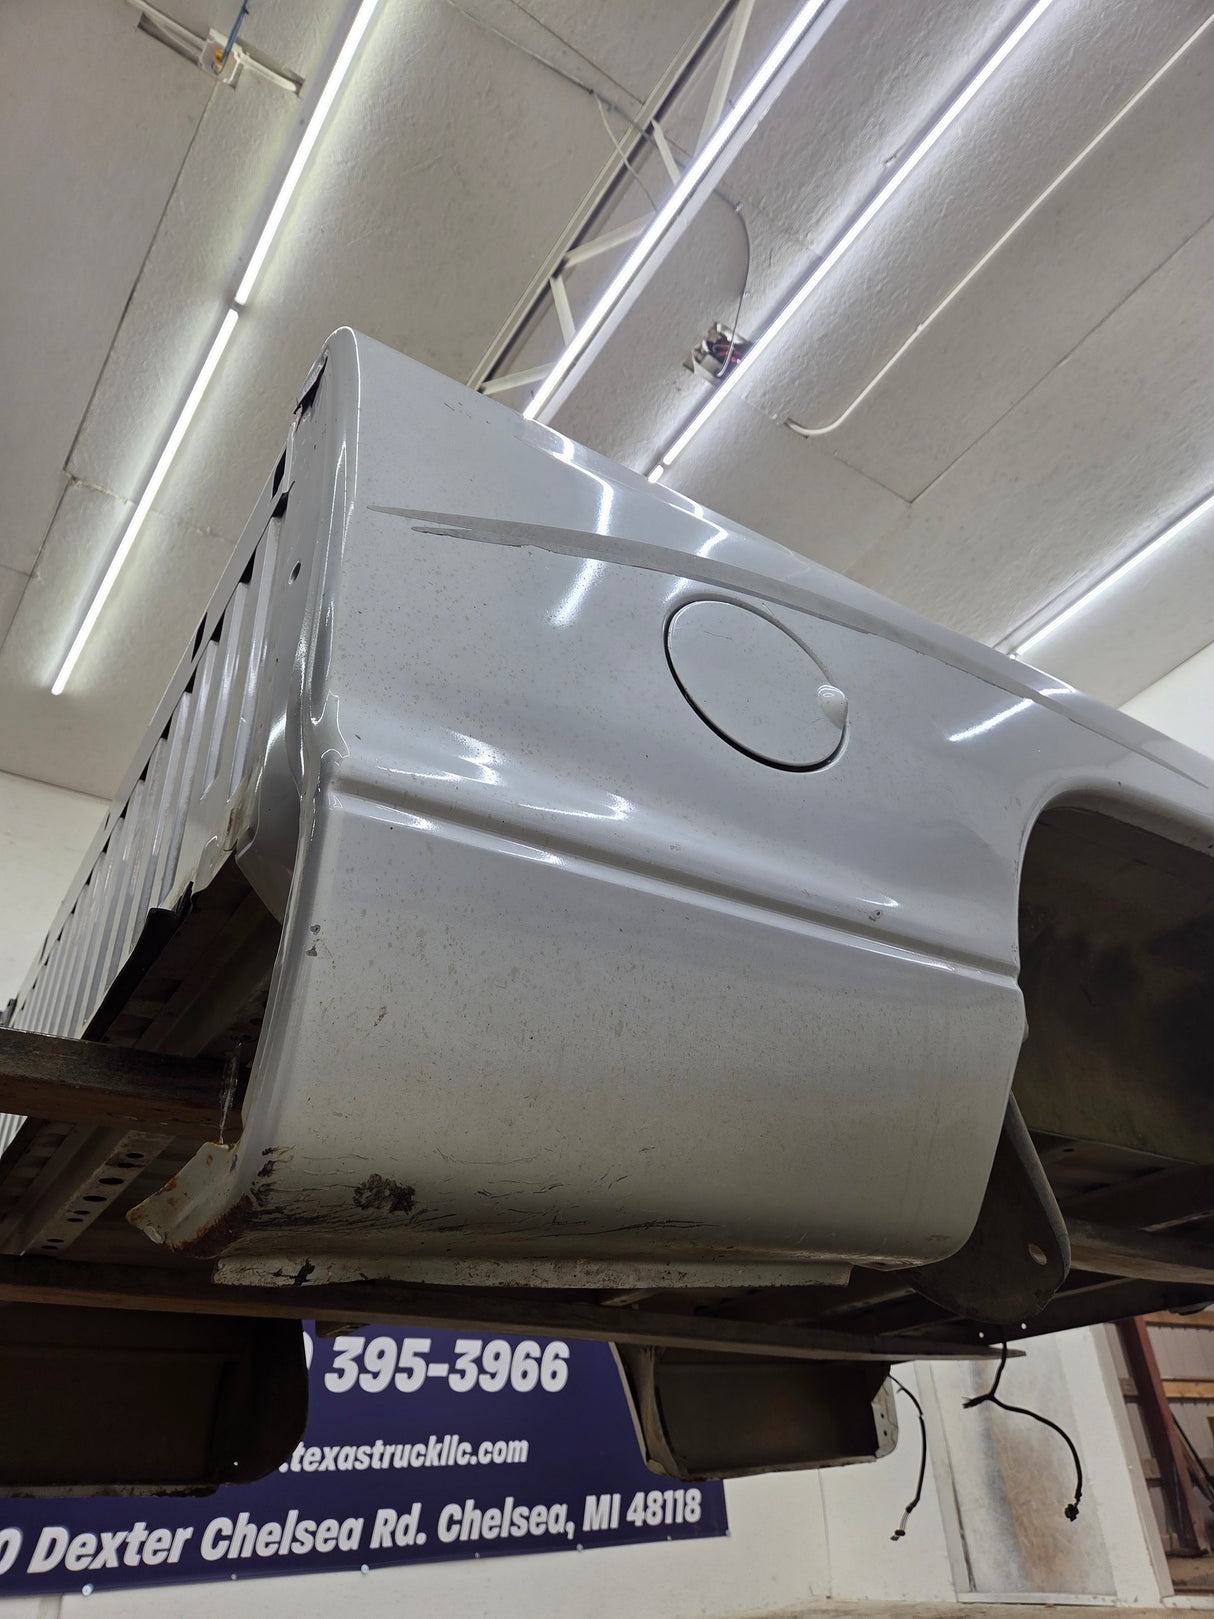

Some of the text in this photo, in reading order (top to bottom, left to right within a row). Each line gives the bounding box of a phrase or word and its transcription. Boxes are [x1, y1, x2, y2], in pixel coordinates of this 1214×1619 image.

[324, 1336, 571, 1393] 395-3966
[26, 1521, 194, 1574] Dexter
[200, 1509, 364, 1561] Chelsea
[369, 1502, 427, 1549] Rd.
[437, 1496, 575, 1540] Chelsea,
[582, 1493, 621, 1531] MI
[626, 1488, 702, 1527] 48118
